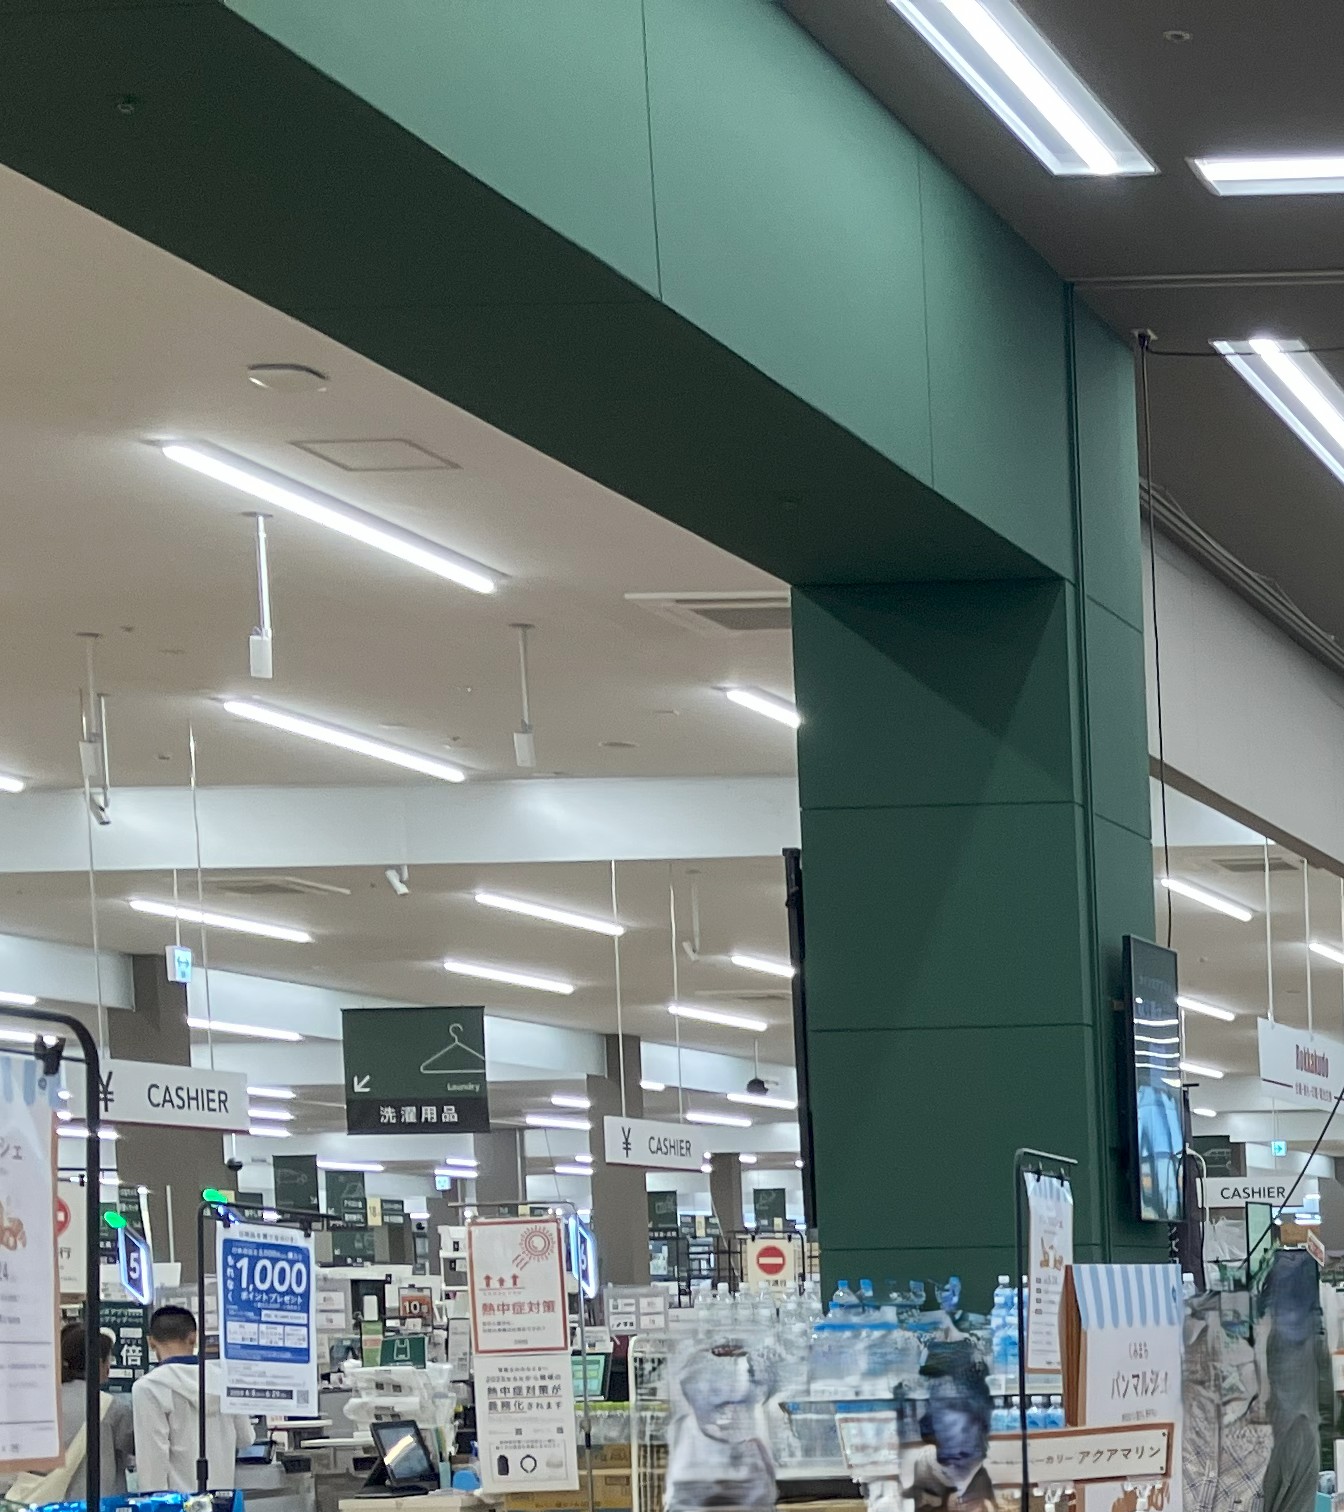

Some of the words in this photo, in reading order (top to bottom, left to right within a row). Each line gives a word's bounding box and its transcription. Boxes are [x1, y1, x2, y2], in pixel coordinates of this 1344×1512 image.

[447, 1083, 481, 1092] Laundry
[147, 1083, 229, 1114] CASHIER
[380, 1105, 459, 1124] 洗濯用品
[648, 1136, 692, 1157] CASHIER
[1220, 1186, 1286, 1200] CASHIER
[129, 1252, 140, 1280] 5
[236, 1257, 307, 1294] 1,000
[241, 1291, 303, 1305] ポイントプレゼント
[482, 1300, 556, 1316] 熱中症対策
[120, 1345, 143, 1366] 倍
[487, 1384, 562, 1397] 熱中症対策が
[1111, 1368, 1169, 1401] パンマルシェ
[1078, 1445, 1160, 1465] アクアマリン
